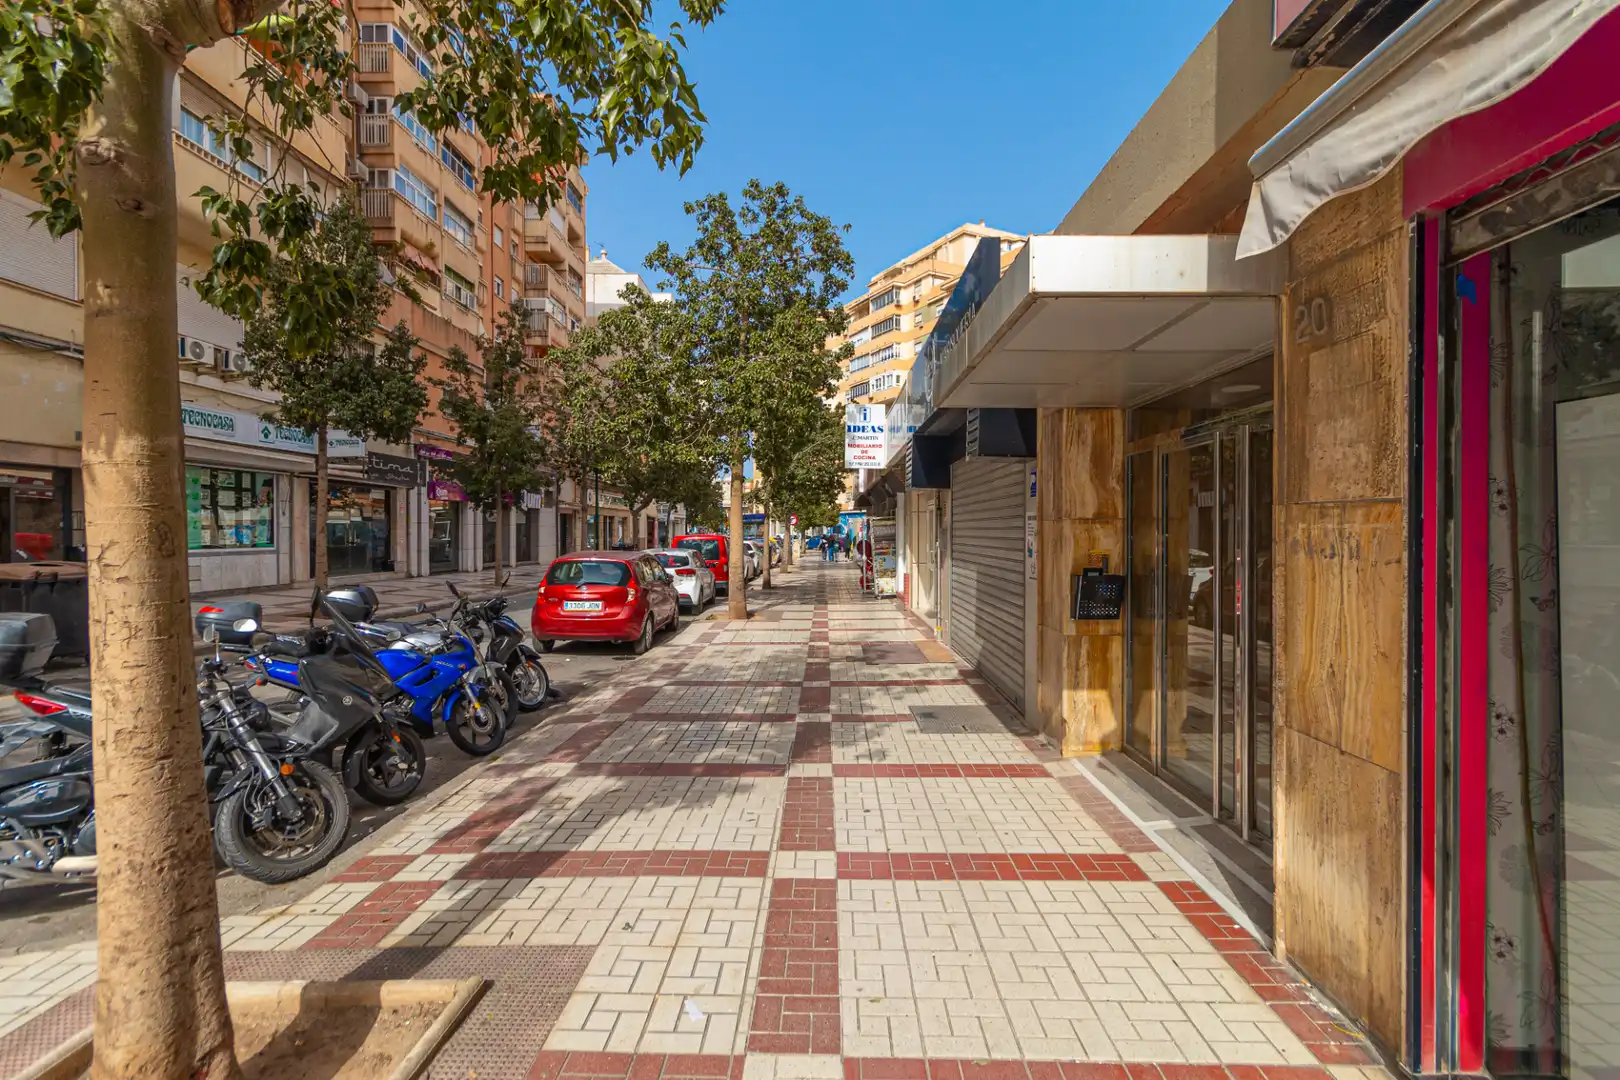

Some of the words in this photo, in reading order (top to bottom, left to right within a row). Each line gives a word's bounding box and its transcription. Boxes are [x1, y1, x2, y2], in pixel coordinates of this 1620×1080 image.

[1294, 297, 1328, 344] 20
[182, 408, 235, 432] TECNOCASA
[847, 425, 884, 433] IDEAS
